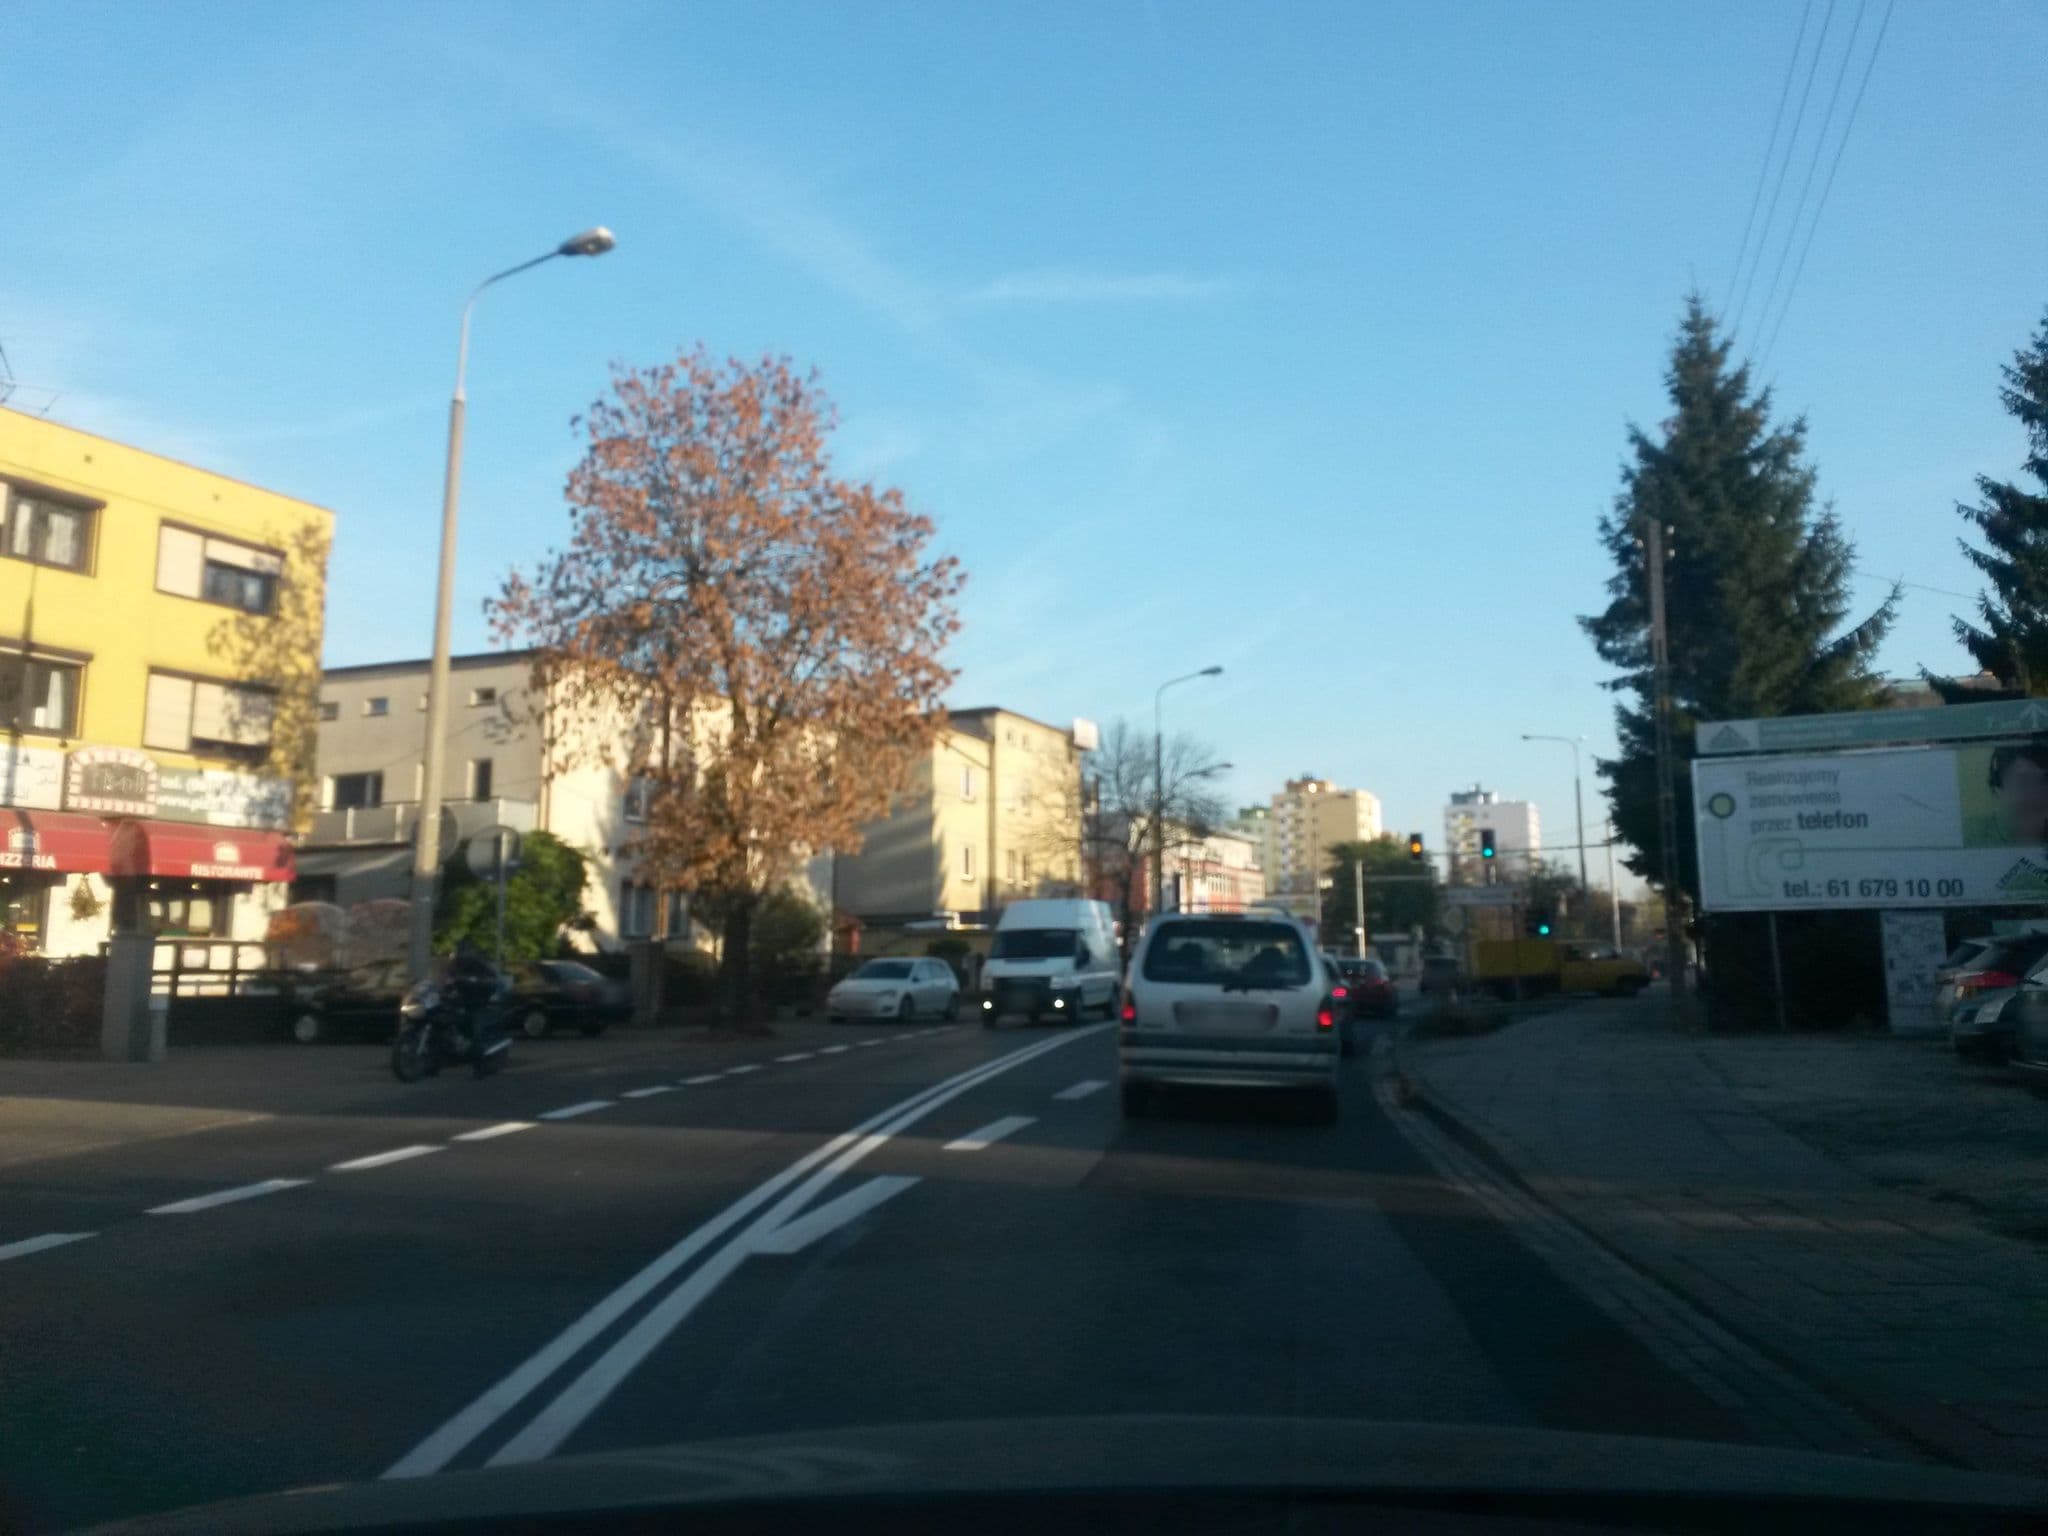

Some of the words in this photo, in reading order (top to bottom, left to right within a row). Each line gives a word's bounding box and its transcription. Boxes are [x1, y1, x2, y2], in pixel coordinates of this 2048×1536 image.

[1750, 817, 1792, 834] przez
[1797, 810, 1868, 830] telefon
[191, 863, 264, 881] RISTORANTE
[1827, 879, 1850, 897] 61
[1859, 879, 1898, 897] 679
[1905, 878, 1930, 897] 10
[1937, 878, 1964, 897] 00
